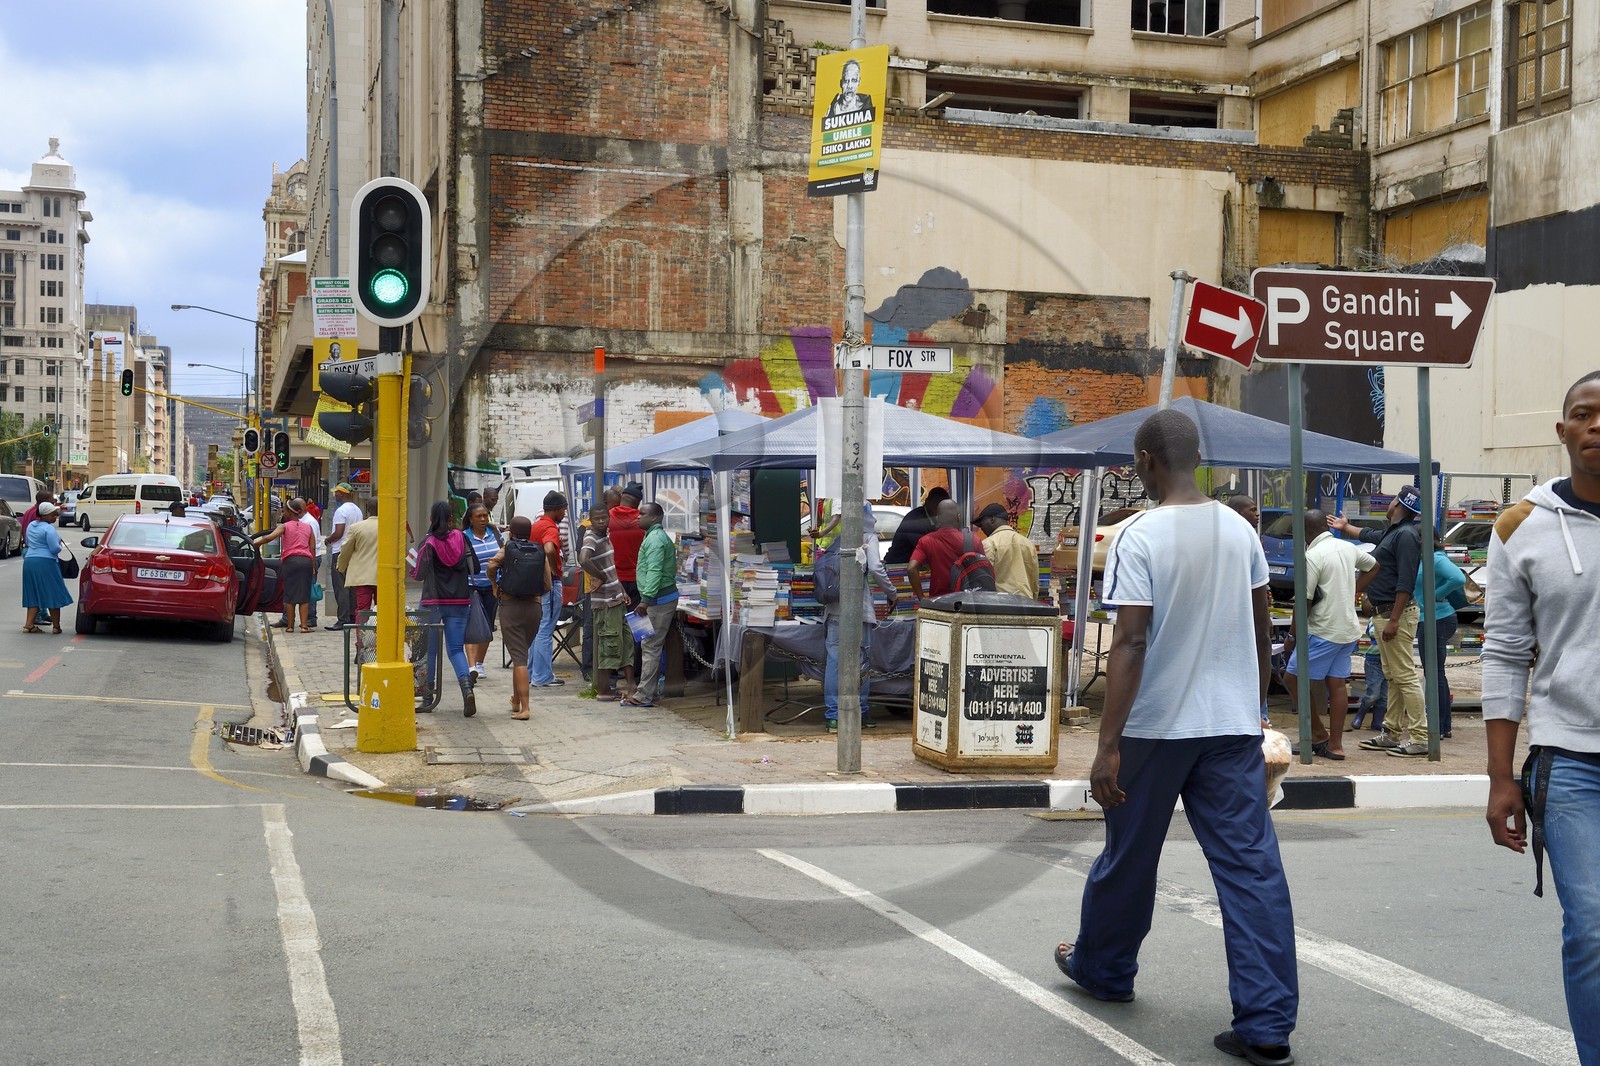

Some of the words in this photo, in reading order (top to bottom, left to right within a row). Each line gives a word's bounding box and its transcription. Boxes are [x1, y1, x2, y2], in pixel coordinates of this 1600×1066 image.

[824, 110, 872, 130] SUKUMA
[832, 127, 862, 141] UMELE
[822, 142, 842, 155] ISIKO
[846, 138, 870, 151] LAKHO
[1267, 286, 1310, 346] P
[1322, 285, 1420, 316] Gandhi
[1324, 322, 1424, 357] Square
[365, 362, 374, 372] STR
[888, 350, 912, 368] FOX
[921, 351, 936, 362] STR
[980, 668, 1033, 682] ADVERTISE
[994, 684, 1019, 698] HERE
[969, 700, 994, 717] (011)
[996, 701, 1042, 715] 514-1400
